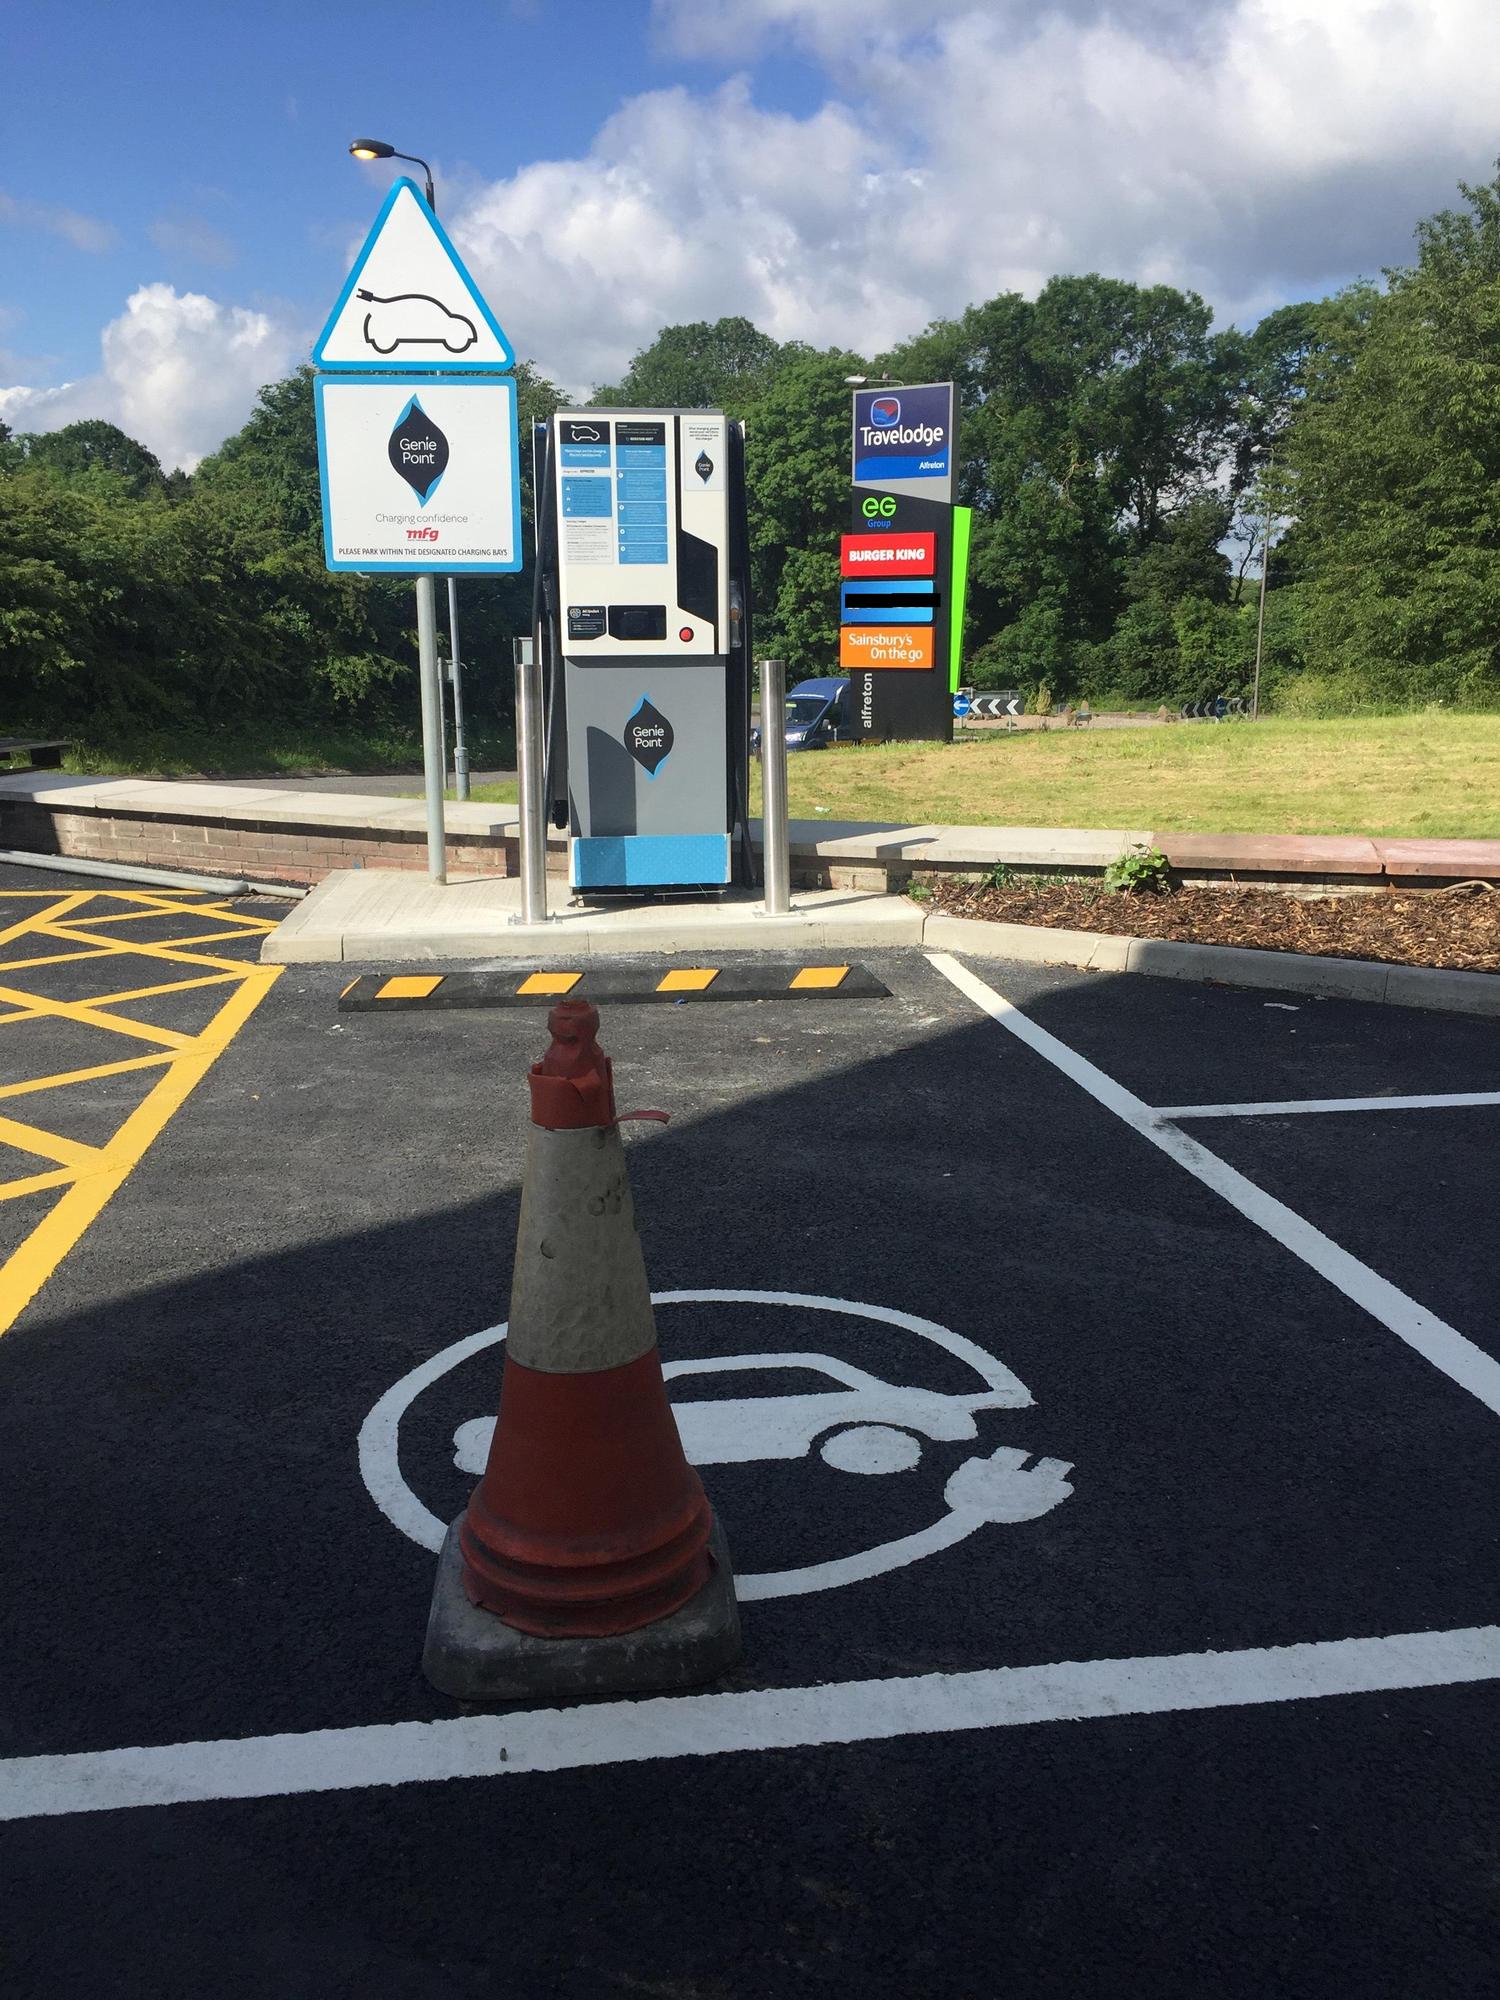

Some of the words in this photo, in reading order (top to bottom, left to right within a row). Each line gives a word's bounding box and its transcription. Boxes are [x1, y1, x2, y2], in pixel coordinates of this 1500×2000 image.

[859, 422, 944, 447] Travelodge
[399, 435, 437, 451] Genie
[402, 452, 435, 464] Point
[919, 461, 945, 470] Alfreton
[375, 513, 416, 525] Charging
[416, 513, 469, 523] confidence
[867, 519, 892, 529] Group
[406, 527, 440, 542] mfg
[338, 548, 361, 556] PLEASE
[362, 548, 378, 556] PARK
[379, 548, 404, 556] WITHIN
[404, 548, 416, 556] THE
[418, 548, 457, 556] DESIGNATED
[492, 549, 508, 557] BAYS
[848, 549, 894, 562] BURGER
[895, 548, 926, 560] KING
[848, 633, 913, 648] Sainsbury's
[870, 647, 887, 660] On
[888, 647, 907, 660] the
[908, 650, 923, 663] go
[861, 672, 873, 729] alfreton
[632, 724, 665, 737] Genie
[635, 738, 663, 748] Point
